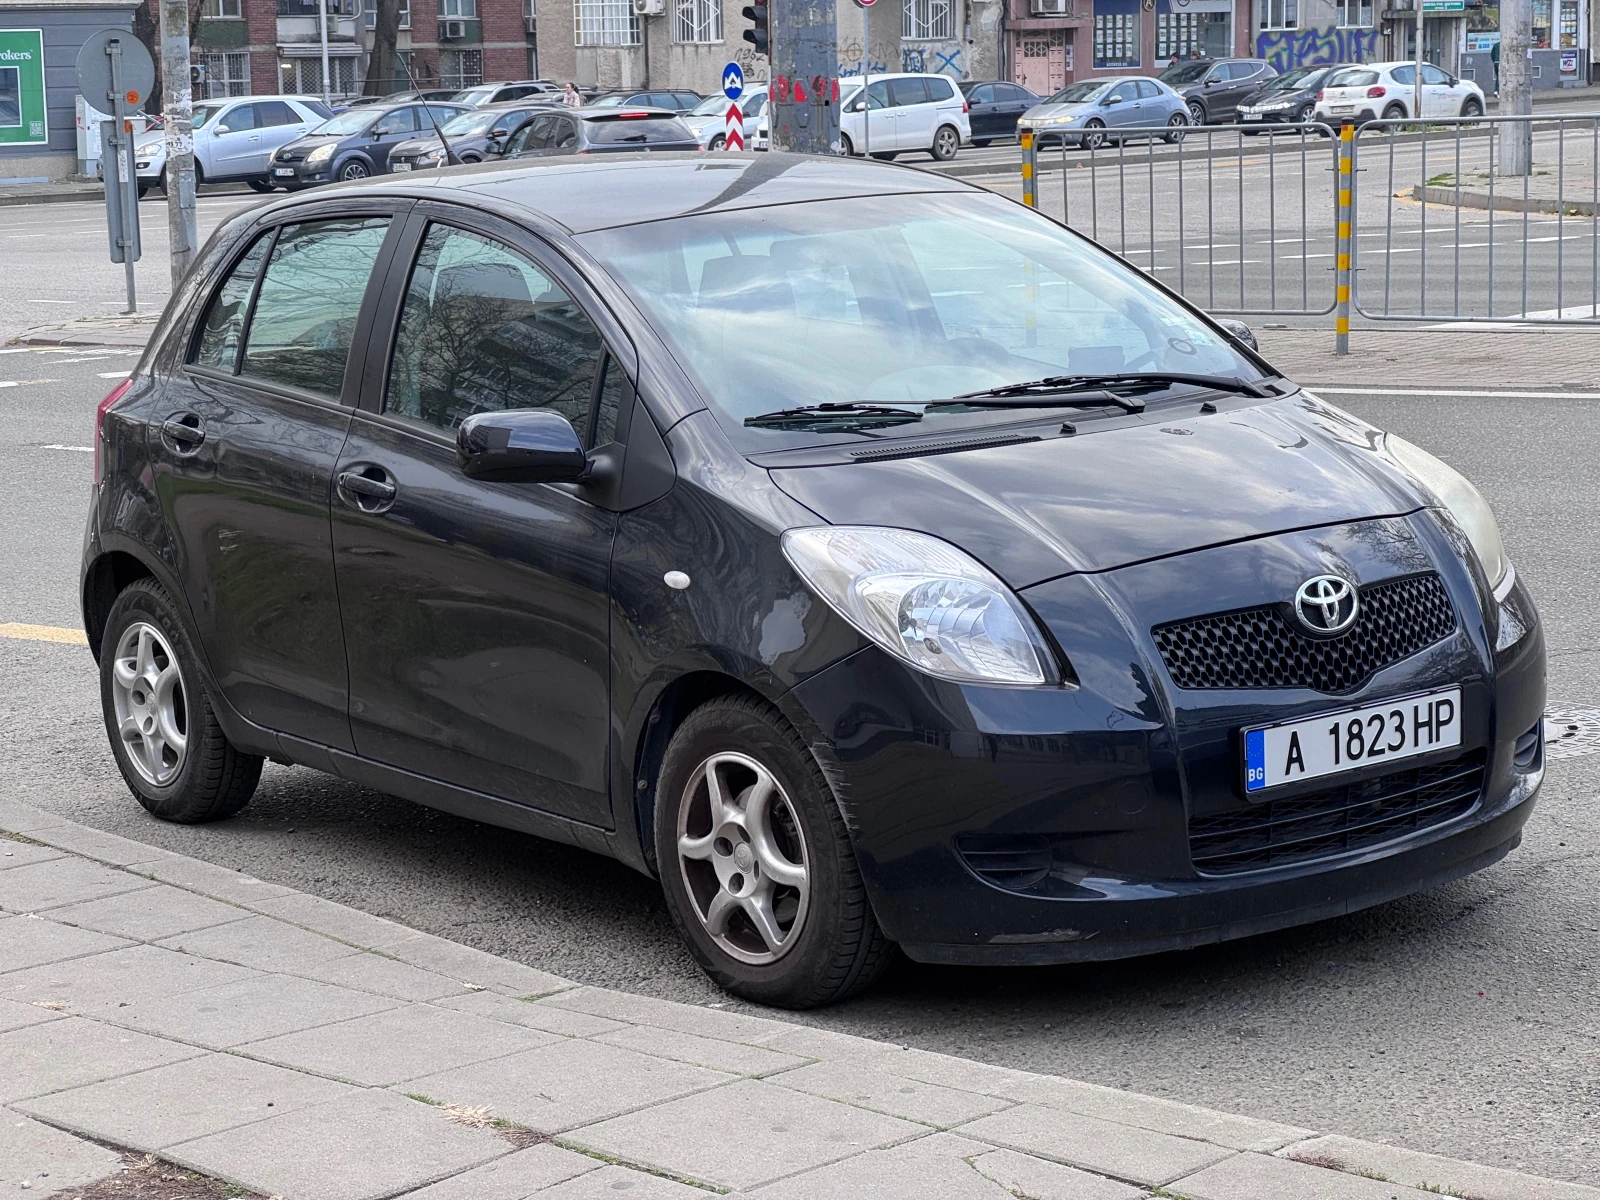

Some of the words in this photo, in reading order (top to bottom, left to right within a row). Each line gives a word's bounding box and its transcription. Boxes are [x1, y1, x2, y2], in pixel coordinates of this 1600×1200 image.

[1285, 730, 1305, 776] A
[1329, 710, 1406, 765] 1823
[1249, 767, 1263, 782] BG
